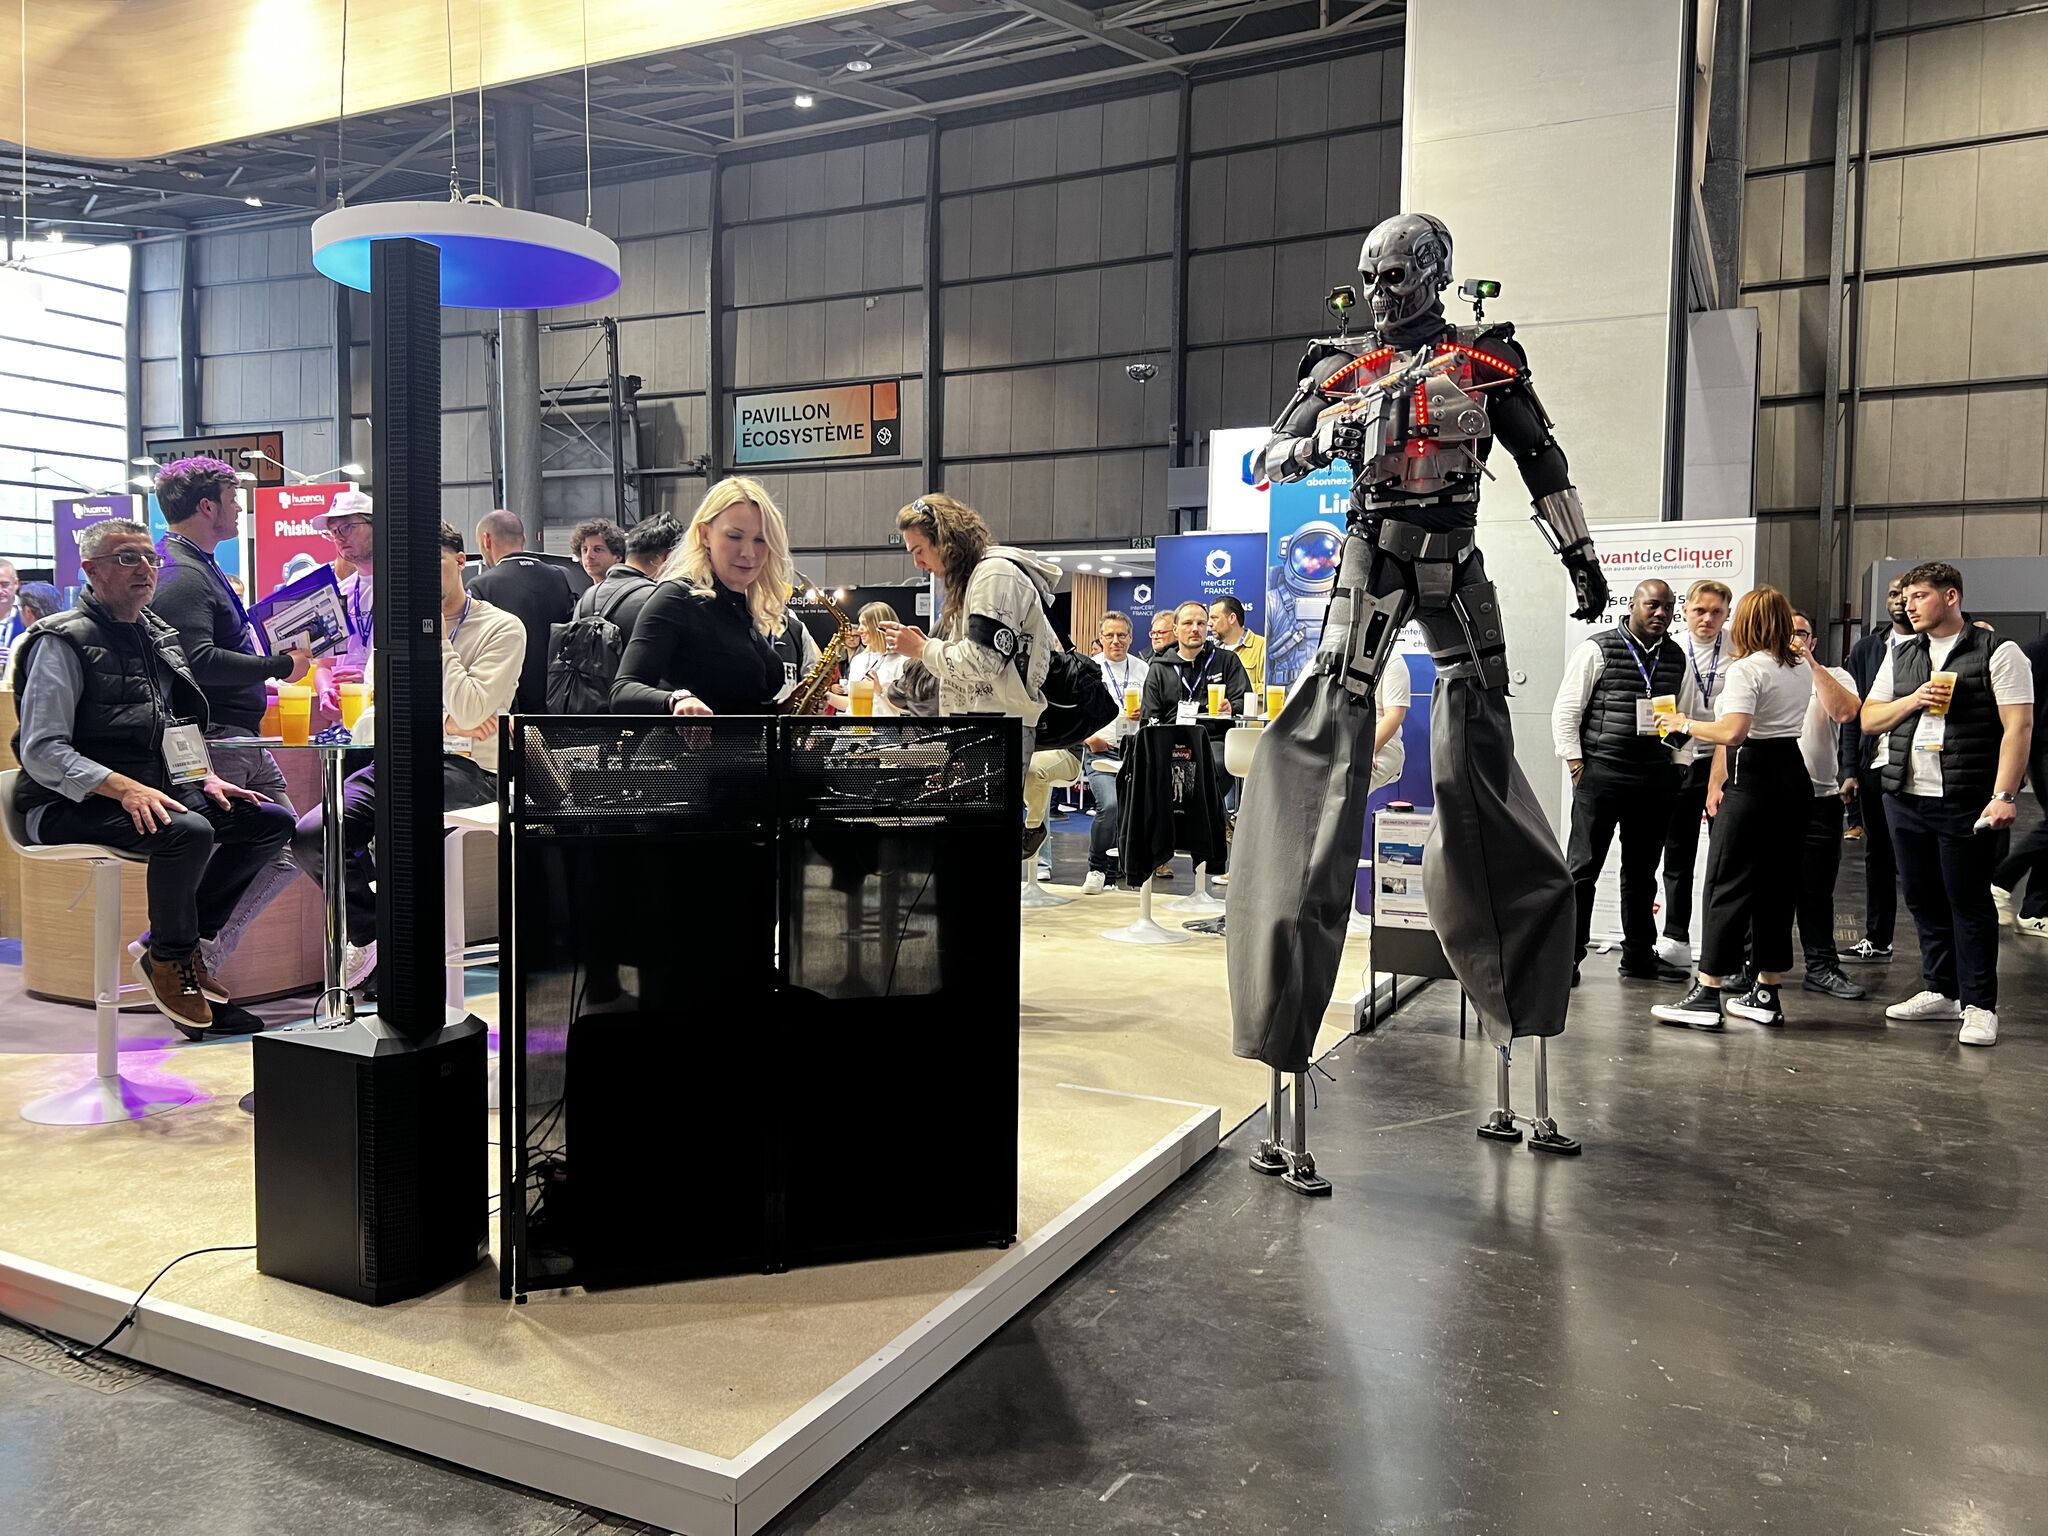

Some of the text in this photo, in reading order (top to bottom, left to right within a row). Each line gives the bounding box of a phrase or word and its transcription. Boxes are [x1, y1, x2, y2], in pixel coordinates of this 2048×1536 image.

[742, 402, 830, 425] PAVILLON
[742, 422, 865, 448] ÉCOSYSTÈME
[1319, 493, 1350, 514] Lin
[275, 519, 322, 537] Phishi
[1600, 547, 1733, 569] vantdeCliquer
[1702, 560, 1733, 569] .com
[1653, 564, 1695, 572] cybersécurité
[1201, 579, 1236, 587] InterCERT
[1204, 587, 1234, 595] FRANCE
